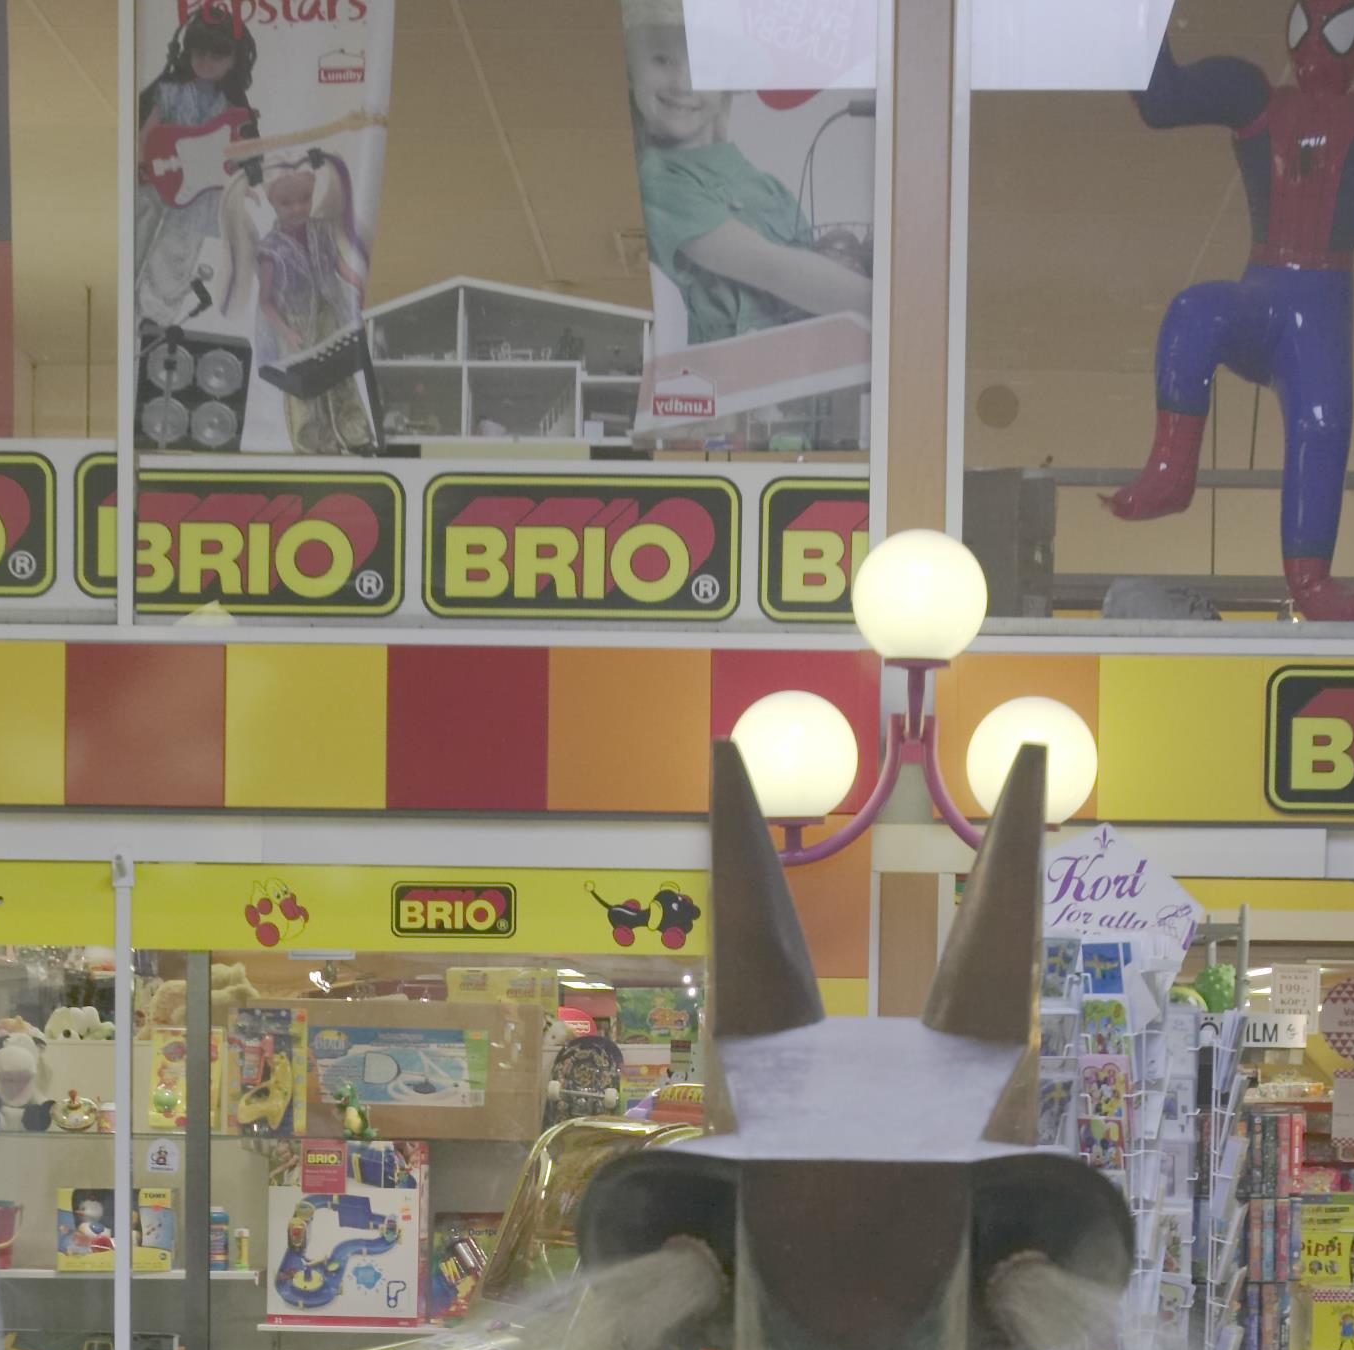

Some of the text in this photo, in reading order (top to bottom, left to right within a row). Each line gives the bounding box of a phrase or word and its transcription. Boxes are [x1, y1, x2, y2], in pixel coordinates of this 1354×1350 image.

[320, 69, 364, 82] Lundby
[445, 522, 690, 603] BRIO
[399, 899, 497, 931] BRIO
[306, 1152, 338, 1165] BRIO
